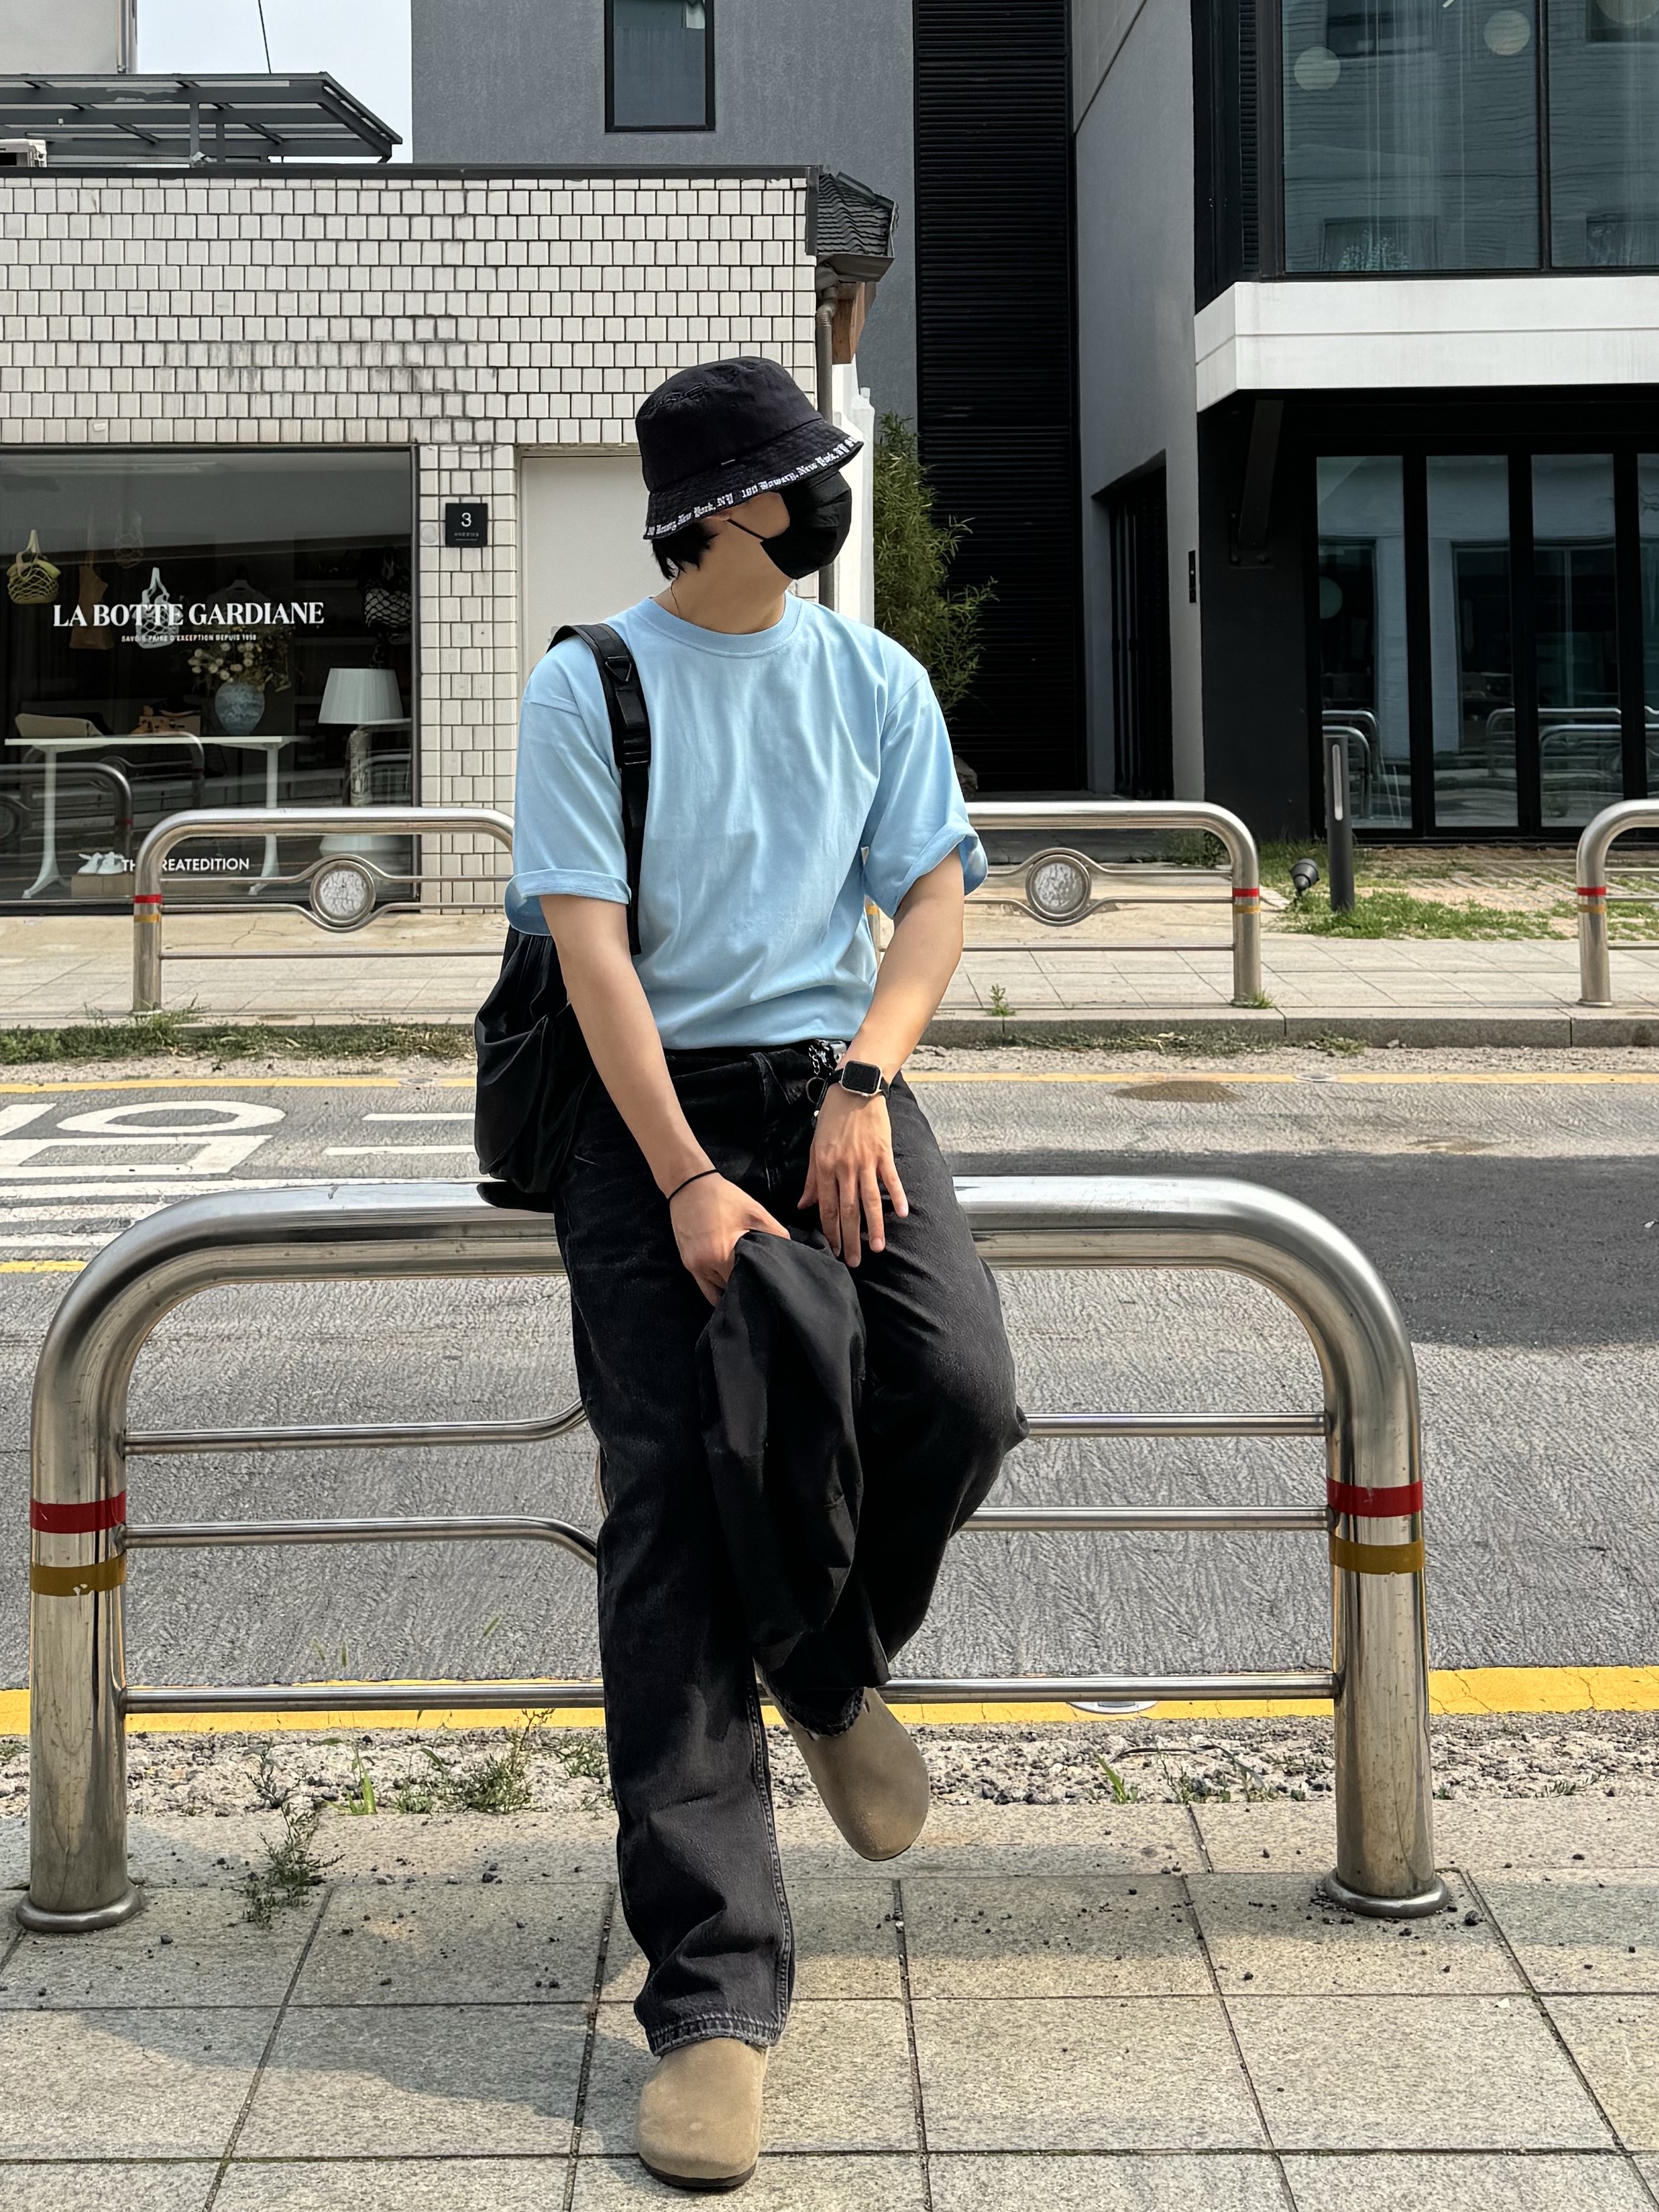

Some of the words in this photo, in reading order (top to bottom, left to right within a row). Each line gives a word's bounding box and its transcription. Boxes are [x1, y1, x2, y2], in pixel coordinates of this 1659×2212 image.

[461, 512, 472, 528] 3
[53, 604, 88, 627] LA
[93, 603, 183, 627] BOTTE
[188, 602, 325, 625] GARDIANE
